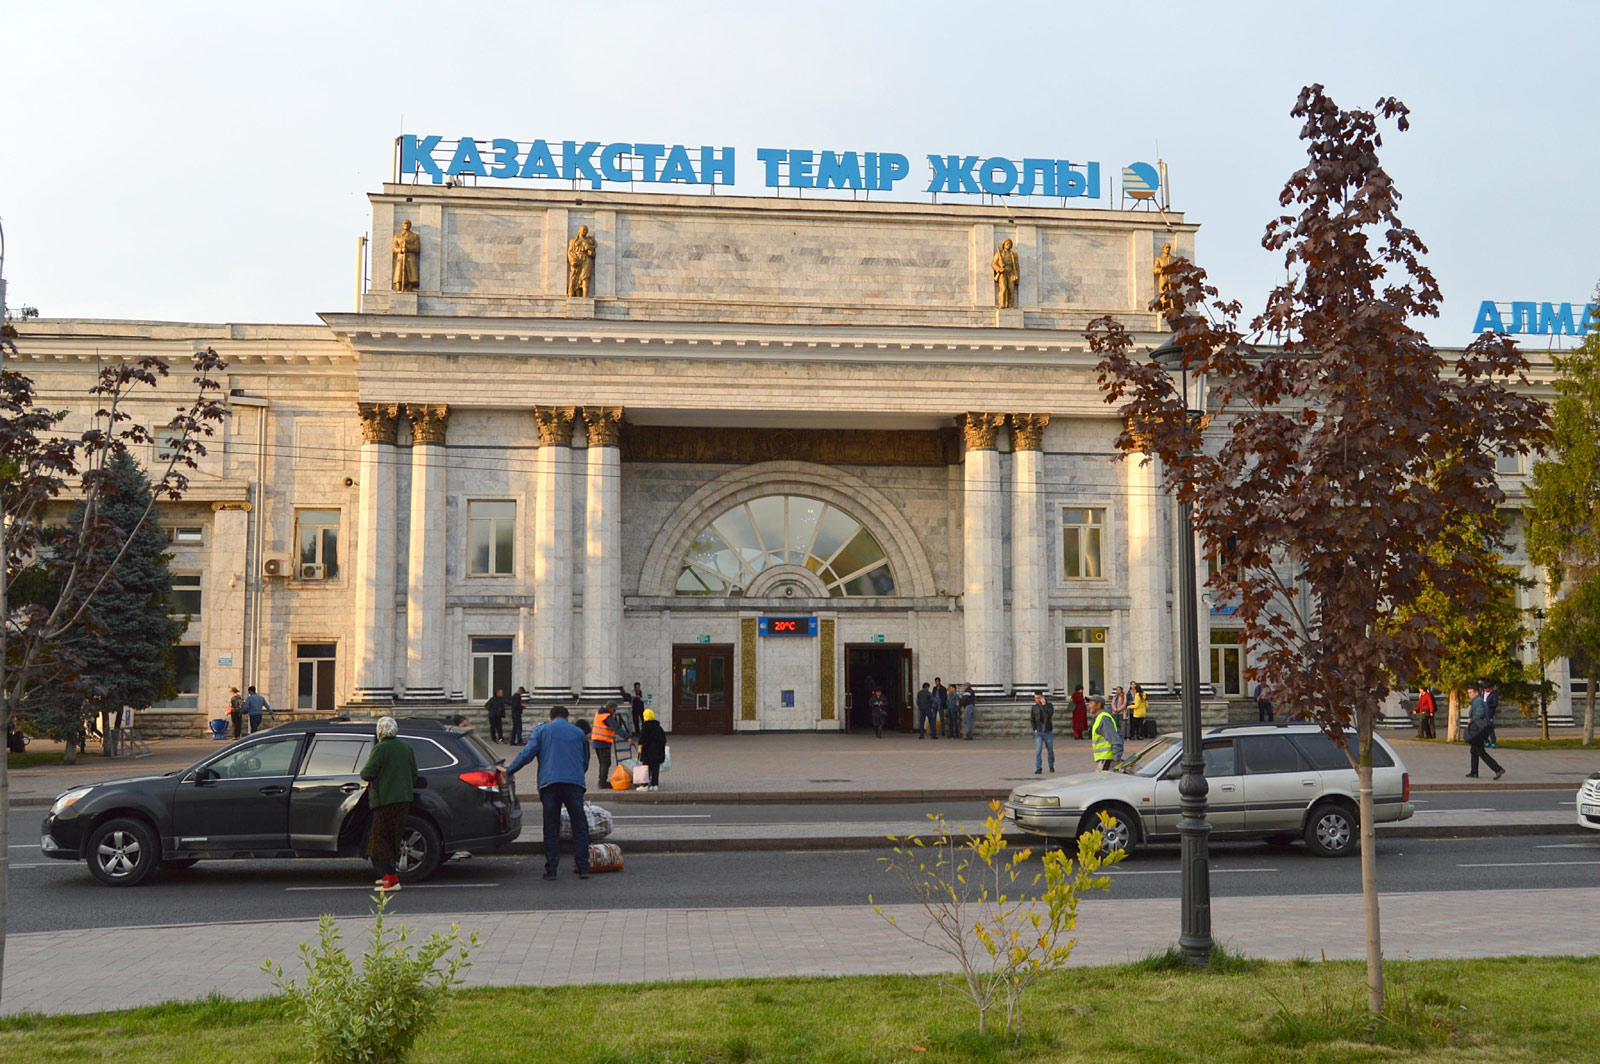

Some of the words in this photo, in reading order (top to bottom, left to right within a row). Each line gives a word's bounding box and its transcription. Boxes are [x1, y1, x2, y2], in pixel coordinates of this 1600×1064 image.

[402, 134, 735, 189] ҚАЗАҚСТАН
[757, 148, 909, 191] ТЕМІР
[927, 154, 1100, 198] ЖОЛЫ
